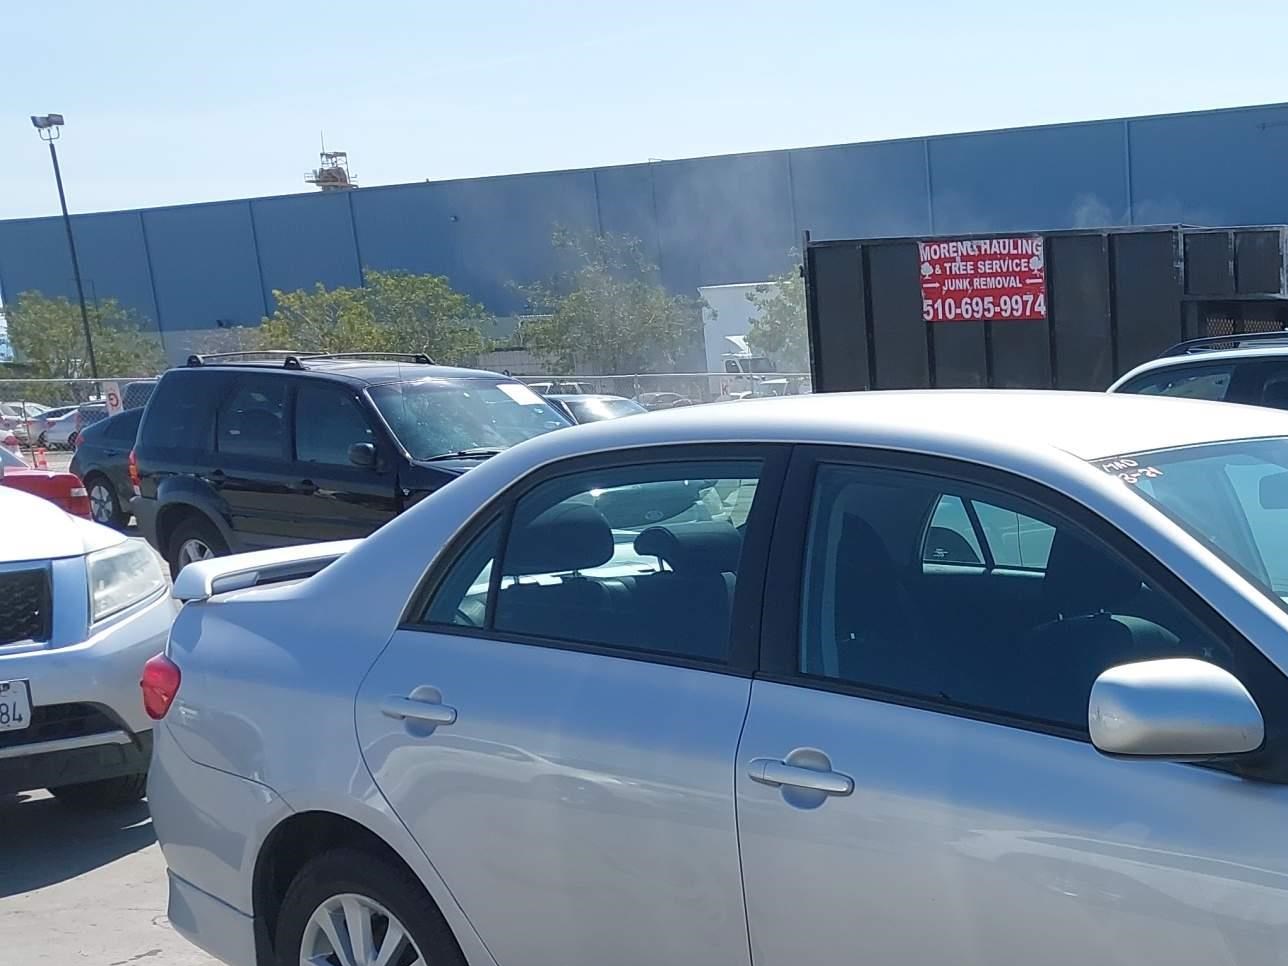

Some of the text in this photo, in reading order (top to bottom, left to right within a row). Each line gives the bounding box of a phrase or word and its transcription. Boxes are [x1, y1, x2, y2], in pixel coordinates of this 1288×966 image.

[980, 239, 1042, 256] HAULING
[934, 258, 1029, 275] & TREE SERVICE
[942, 276, 1023, 291] JUNK REMOVAL
[922, 294, 1046, 320] 510-695-9974
